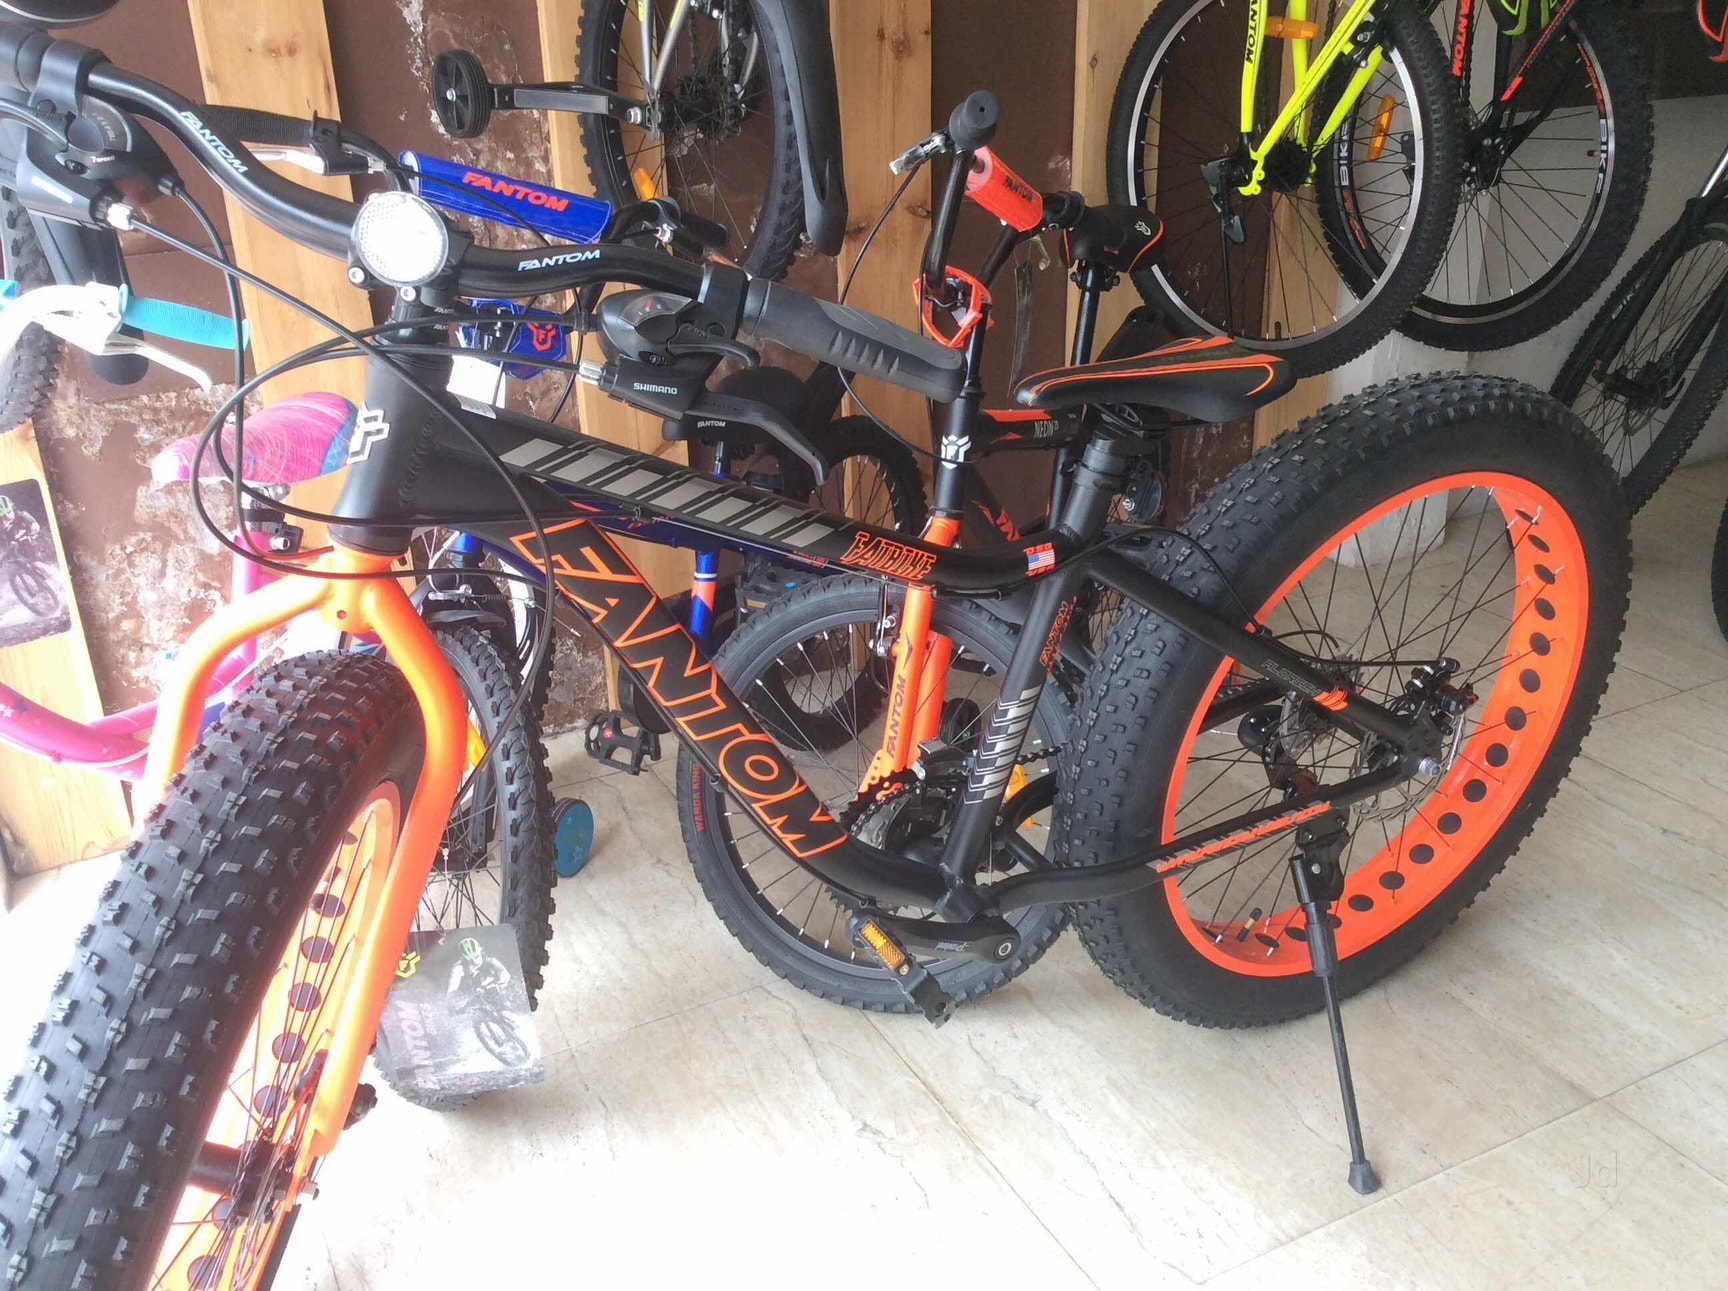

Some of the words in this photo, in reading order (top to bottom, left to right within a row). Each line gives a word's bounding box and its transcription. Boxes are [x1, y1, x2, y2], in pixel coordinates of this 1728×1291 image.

[180, 110, 248, 173] FANTOM
[463, 171, 570, 212] FANTOM
[1002, 175, 1034, 201] FANTOM
[517, 250, 601, 271] FANTOM
[633, 382, 678, 395] SHIMANO
[697, 420, 726, 428] FANTOM
[1033, 421, 1054, 438] NEON
[840, 531, 937, 580] FATBIKE
[1040, 600, 1070, 668] FANTOM
[509, 518, 849, 858] FANTOM
[886, 674, 906, 758] FANTOM
[692, 791, 705, 832] WANDA
